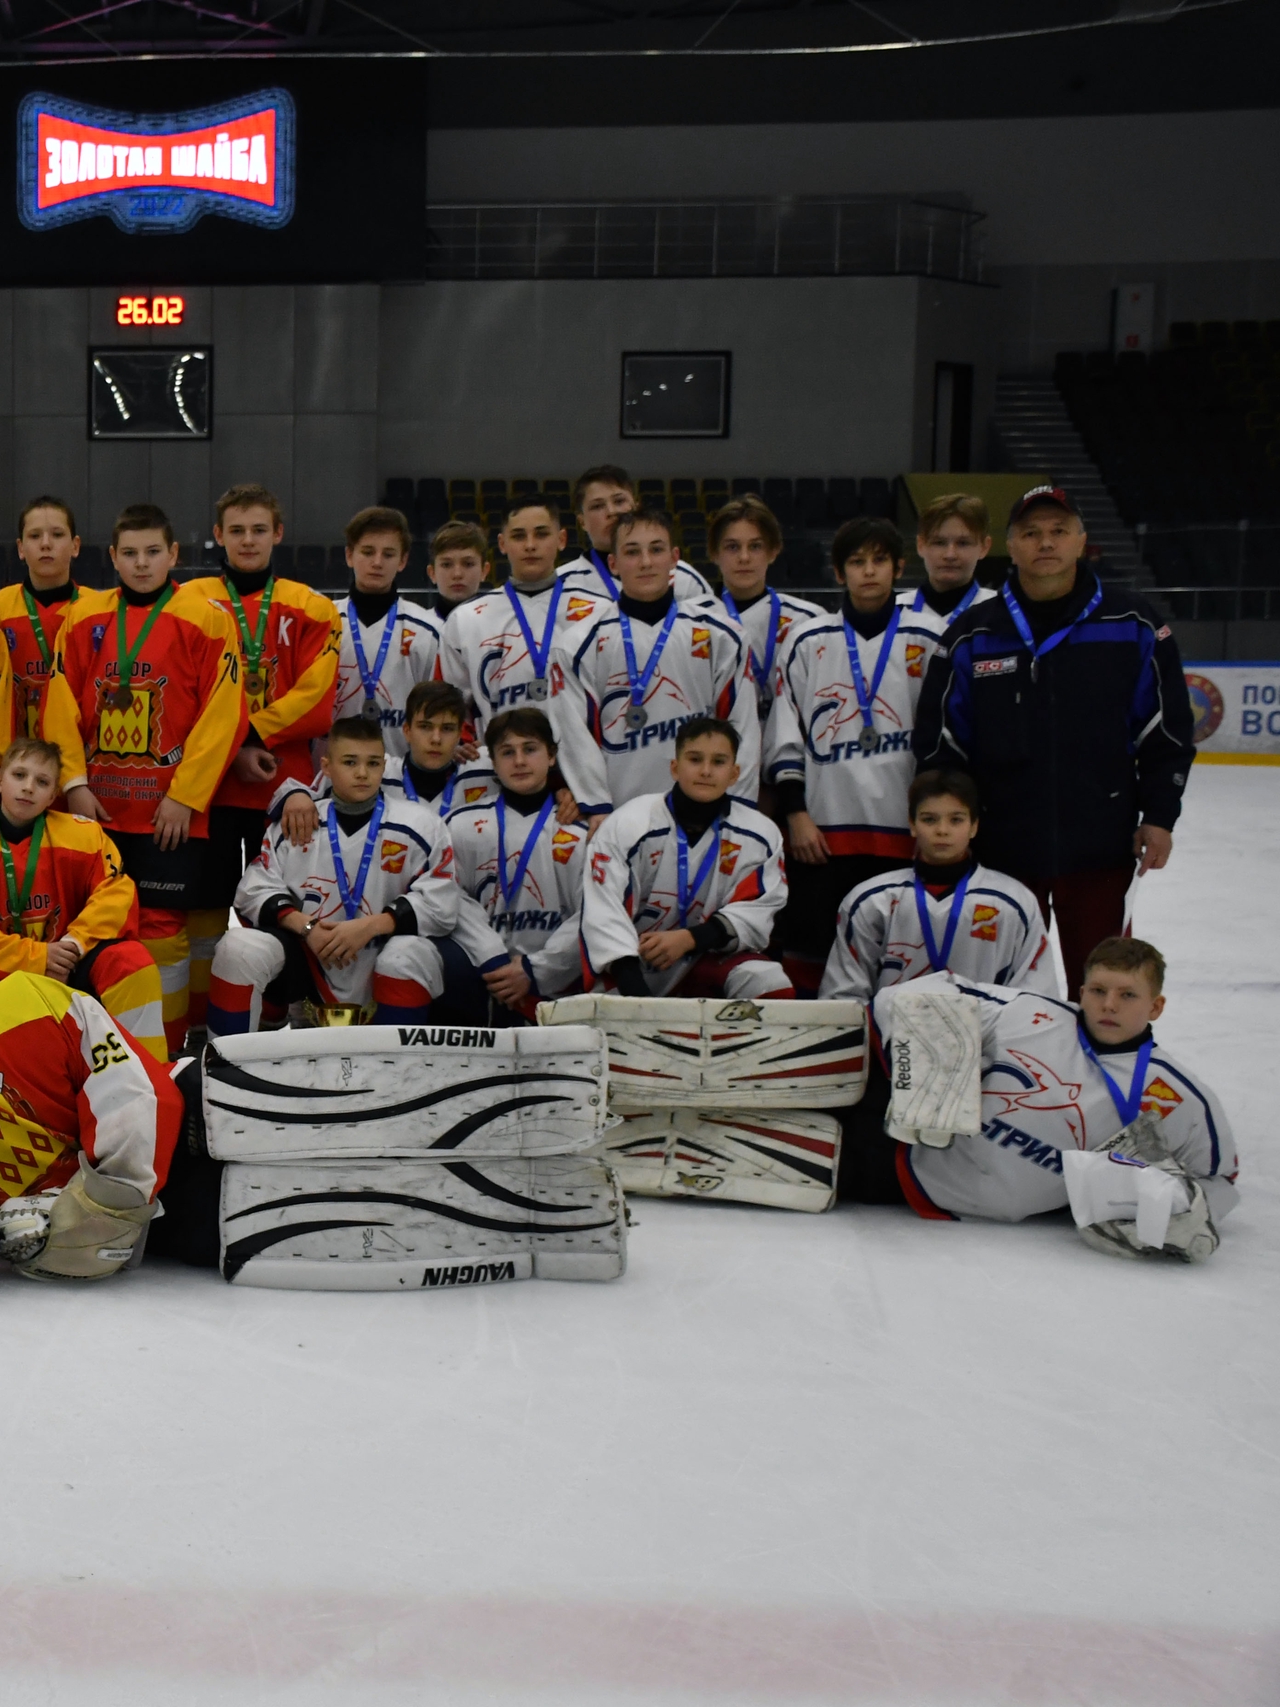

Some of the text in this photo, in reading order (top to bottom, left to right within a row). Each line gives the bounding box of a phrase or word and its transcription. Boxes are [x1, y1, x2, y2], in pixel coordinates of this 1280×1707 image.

[45, 133, 267, 188] ЗОЛОТАЯ ШАЙБА
[129, 196, 185, 217] 2022
[117, 297, 183, 325] 26.02
[1243, 685, 1280, 705] ПО
[808, 701, 911, 763] СТРИЖ
[397, 1028, 496, 1048] VAUGHN
[894, 1039, 911, 1091] Reebok
[421, 1261, 515, 1287] VAUGHN
